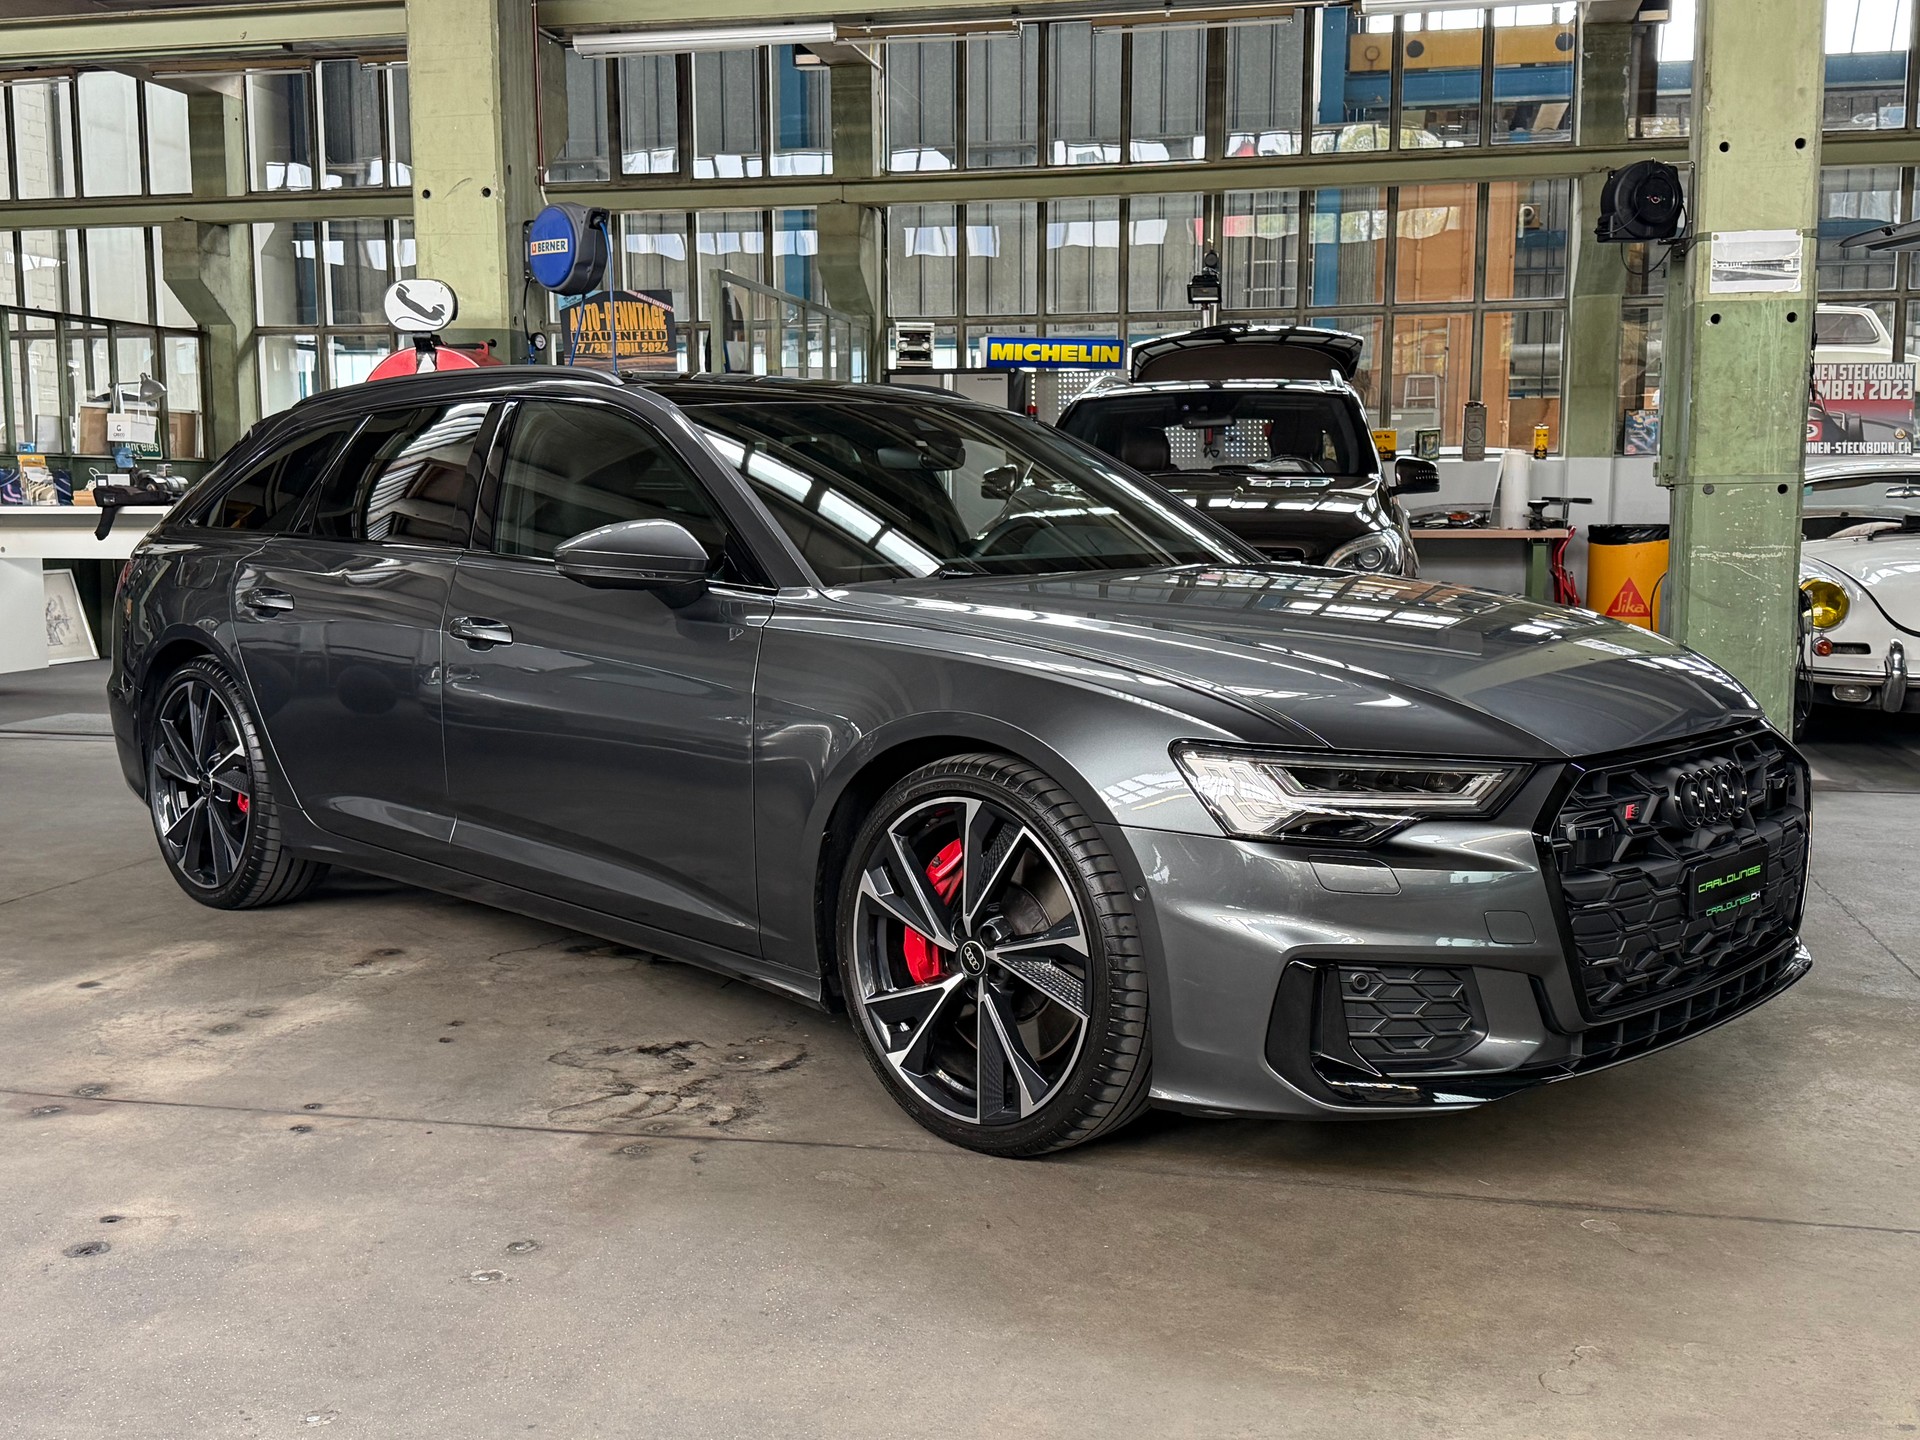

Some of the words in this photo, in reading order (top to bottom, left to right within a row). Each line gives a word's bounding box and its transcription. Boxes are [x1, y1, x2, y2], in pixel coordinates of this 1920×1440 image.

[537, 240, 566, 252] BERNER
[641, 341, 669, 353] 2024
[990, 343, 1120, 362] MICHELIN
[1839, 364, 1914, 380] STECKBORN
[1868, 380, 1913, 400] 2023
[1611, 591, 1645, 613] Sika
[1698, 864, 1761, 893] CARLOUNGE
[1705, 890, 1761, 917] CARLOUNGE.CH
